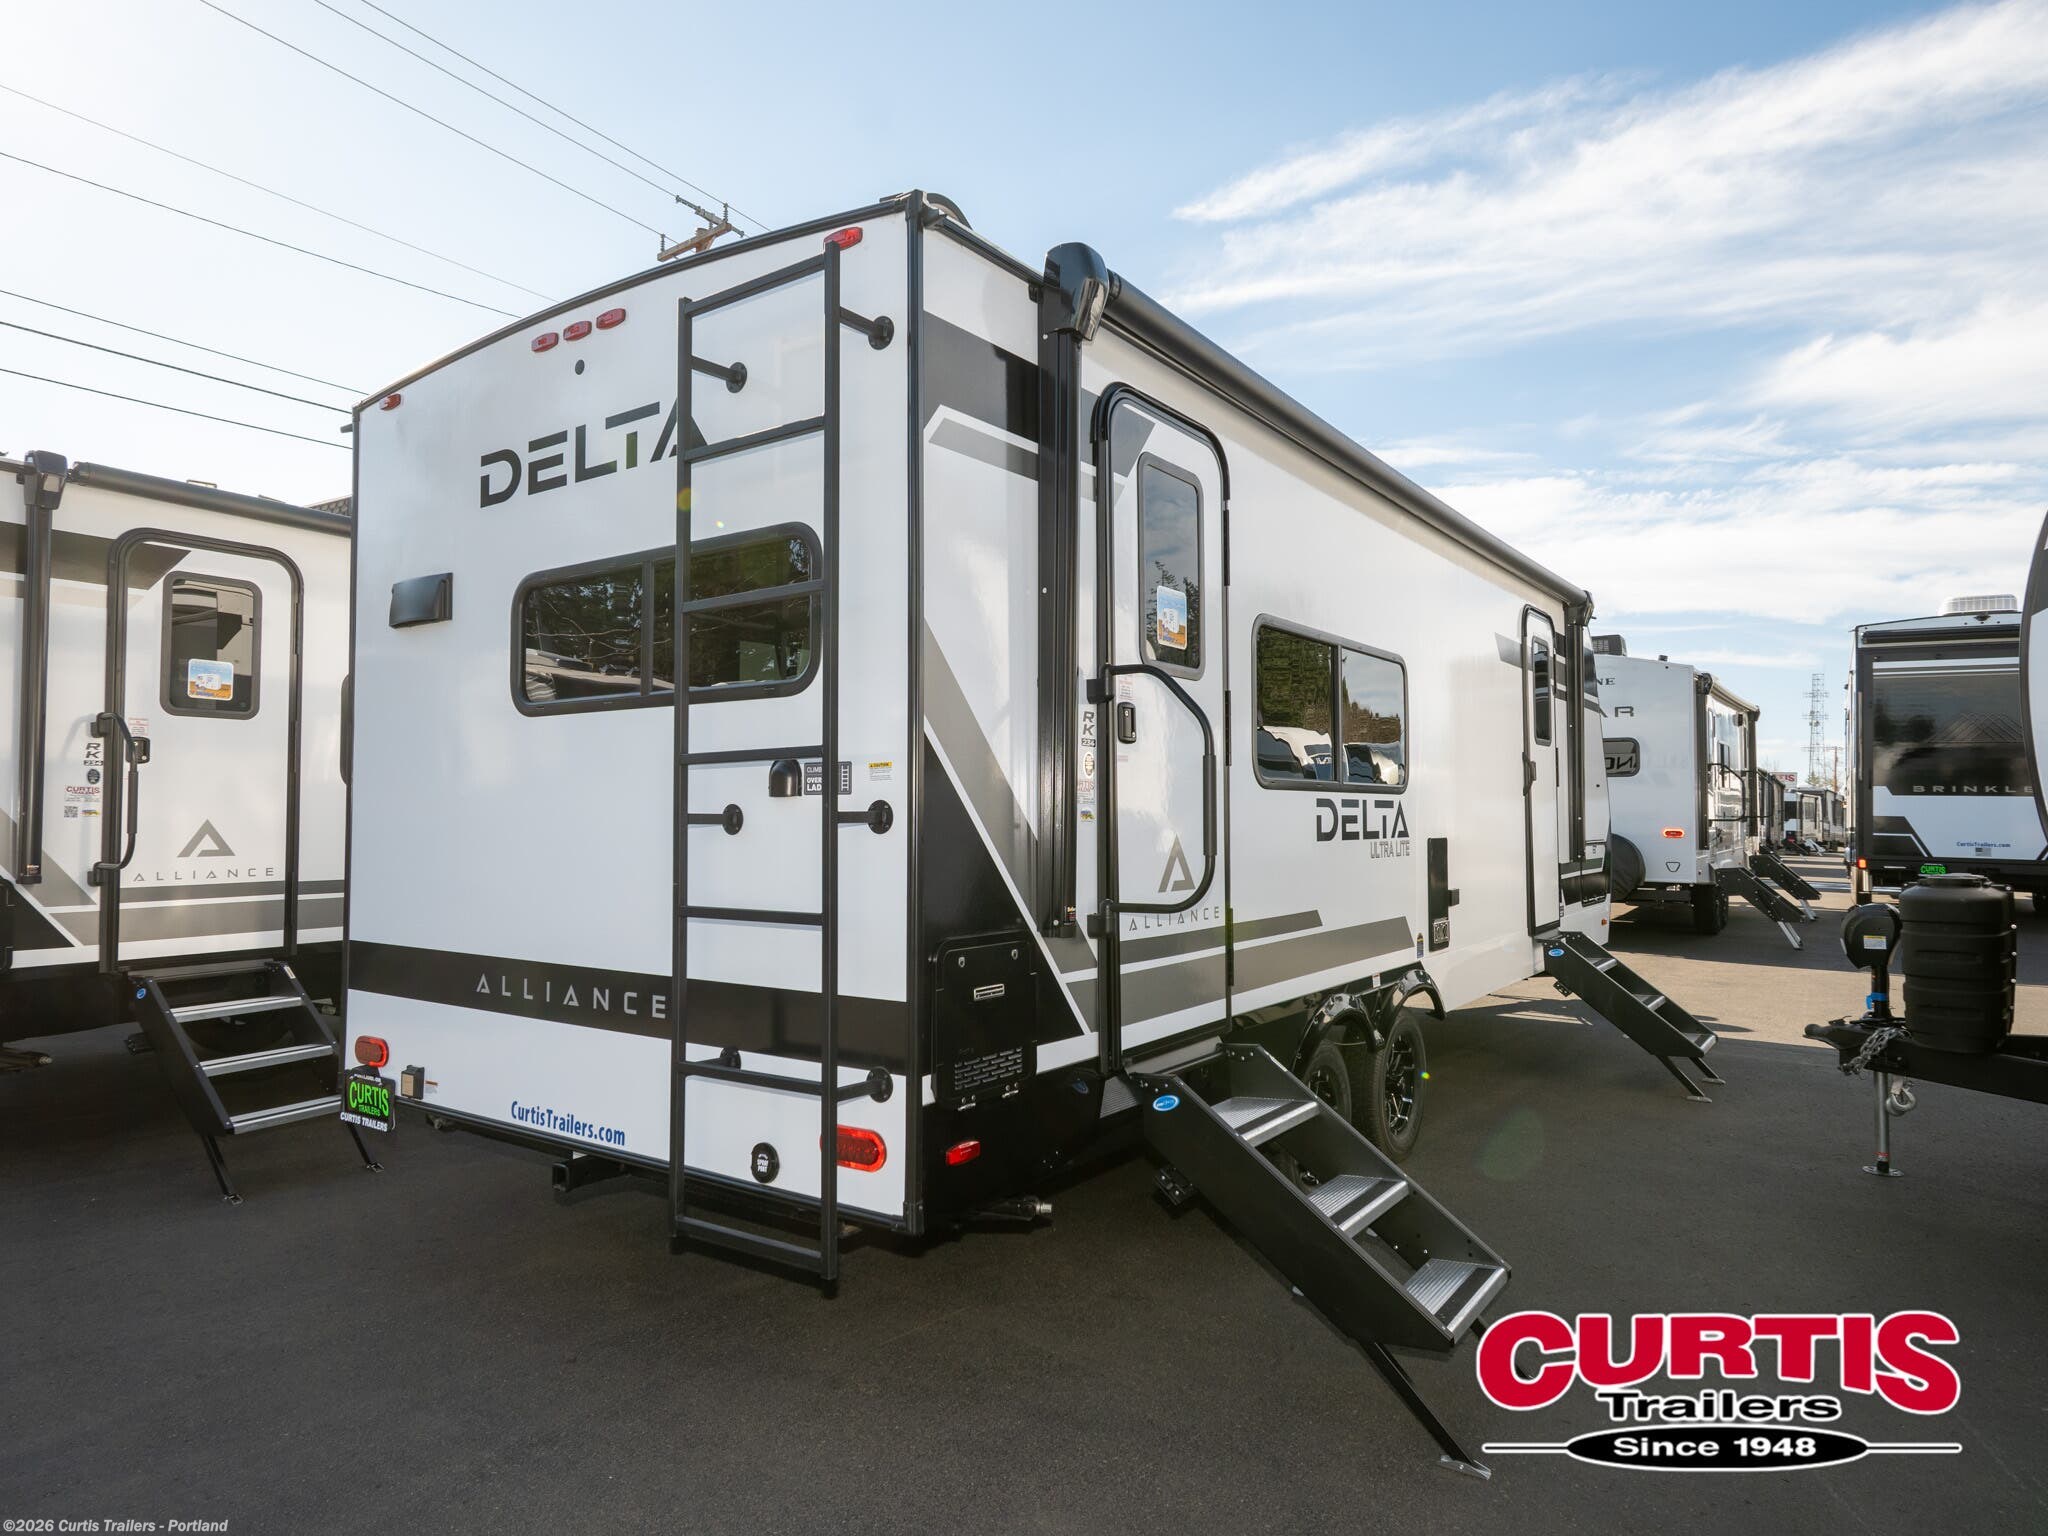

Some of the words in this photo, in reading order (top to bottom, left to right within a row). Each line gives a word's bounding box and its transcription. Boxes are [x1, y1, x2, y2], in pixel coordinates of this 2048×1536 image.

[480, 397, 709, 509] DELTA
[66, 786, 101, 795] CURTIS
[1912, 785, 2033, 793] BRINKLE
[1316, 798, 1410, 842] DELTA
[1370, 840, 1394, 859] ULTRA
[1395, 840, 1410, 857] LITE
[133, 867, 274, 882] ALLIANCE
[1920, 865, 1946, 875] CURTIS
[1128, 906, 1220, 932] ALLIANCE
[476, 973, 666, 1019] ALLIANCE
[349, 1081, 389, 1117] CURTIS
[358, 1104, 381, 1117] TRAILERS
[340, 1111, 361, 1125] CURTIS
[361, 1117, 388, 1132] TRAILERS
[511, 1100, 625, 1146] CurtisTrailers.com
